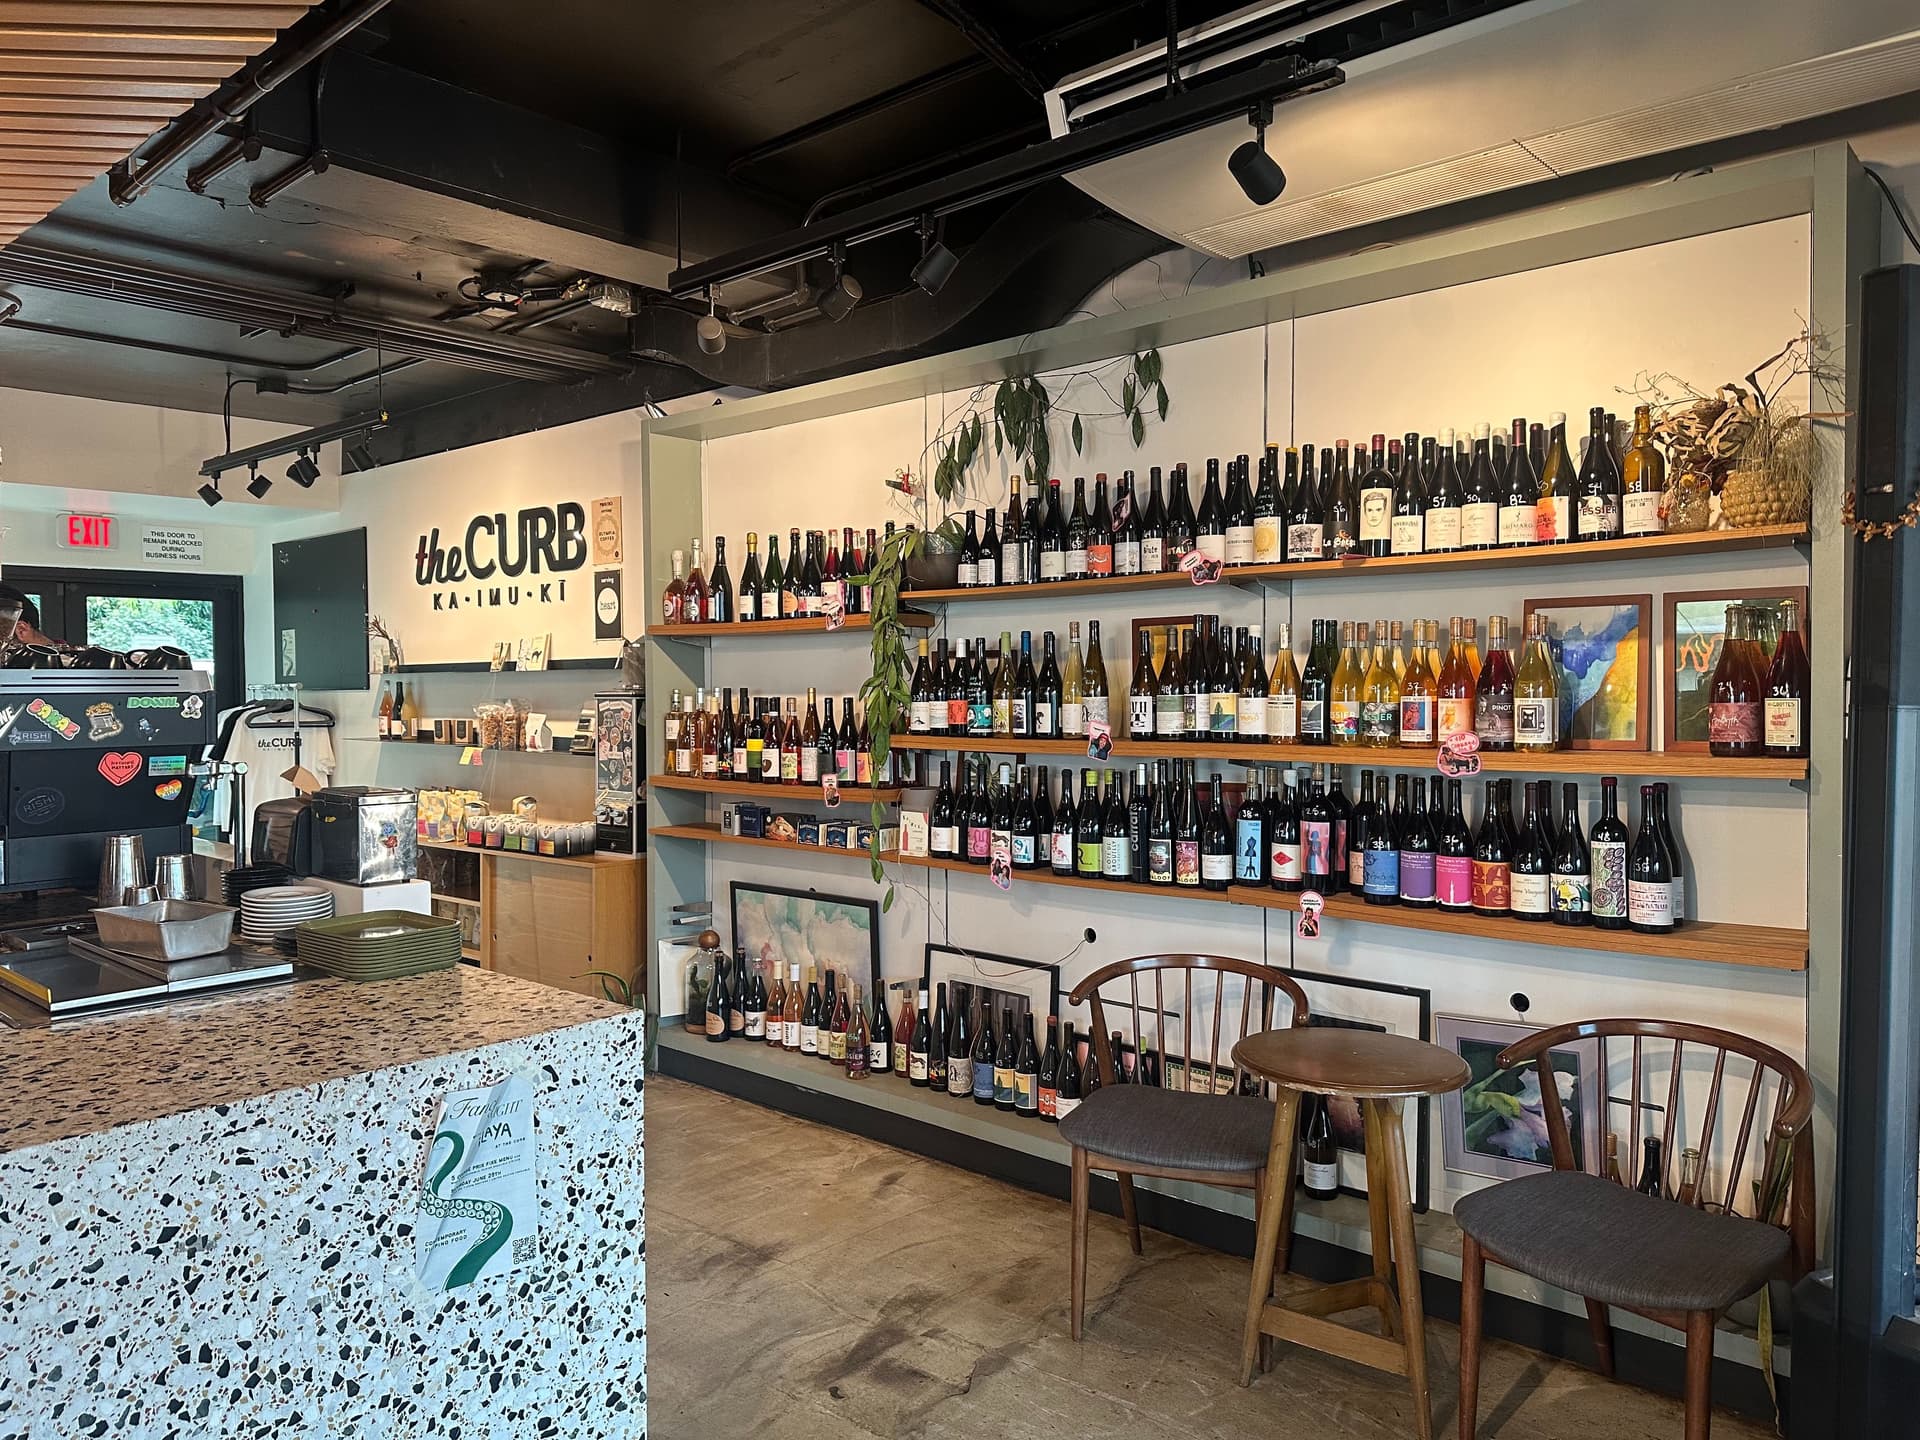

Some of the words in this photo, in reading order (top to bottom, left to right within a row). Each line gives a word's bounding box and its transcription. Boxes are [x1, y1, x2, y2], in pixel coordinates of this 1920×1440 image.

[1629, 480, 1640, 493] 58
[1433, 496, 1446, 507] 57
[68, 516, 112, 548] EXIT
[143, 537, 167, 545] REMAIN
[169, 539, 202, 547] UNLOCKED
[161, 545, 185, 553] DURING
[145, 551, 177, 560] BUSINESS
[22, 732, 51, 740] RISHI
[1558, 864, 1573, 872] 40
[451, 1235, 468, 1243] FOOD
